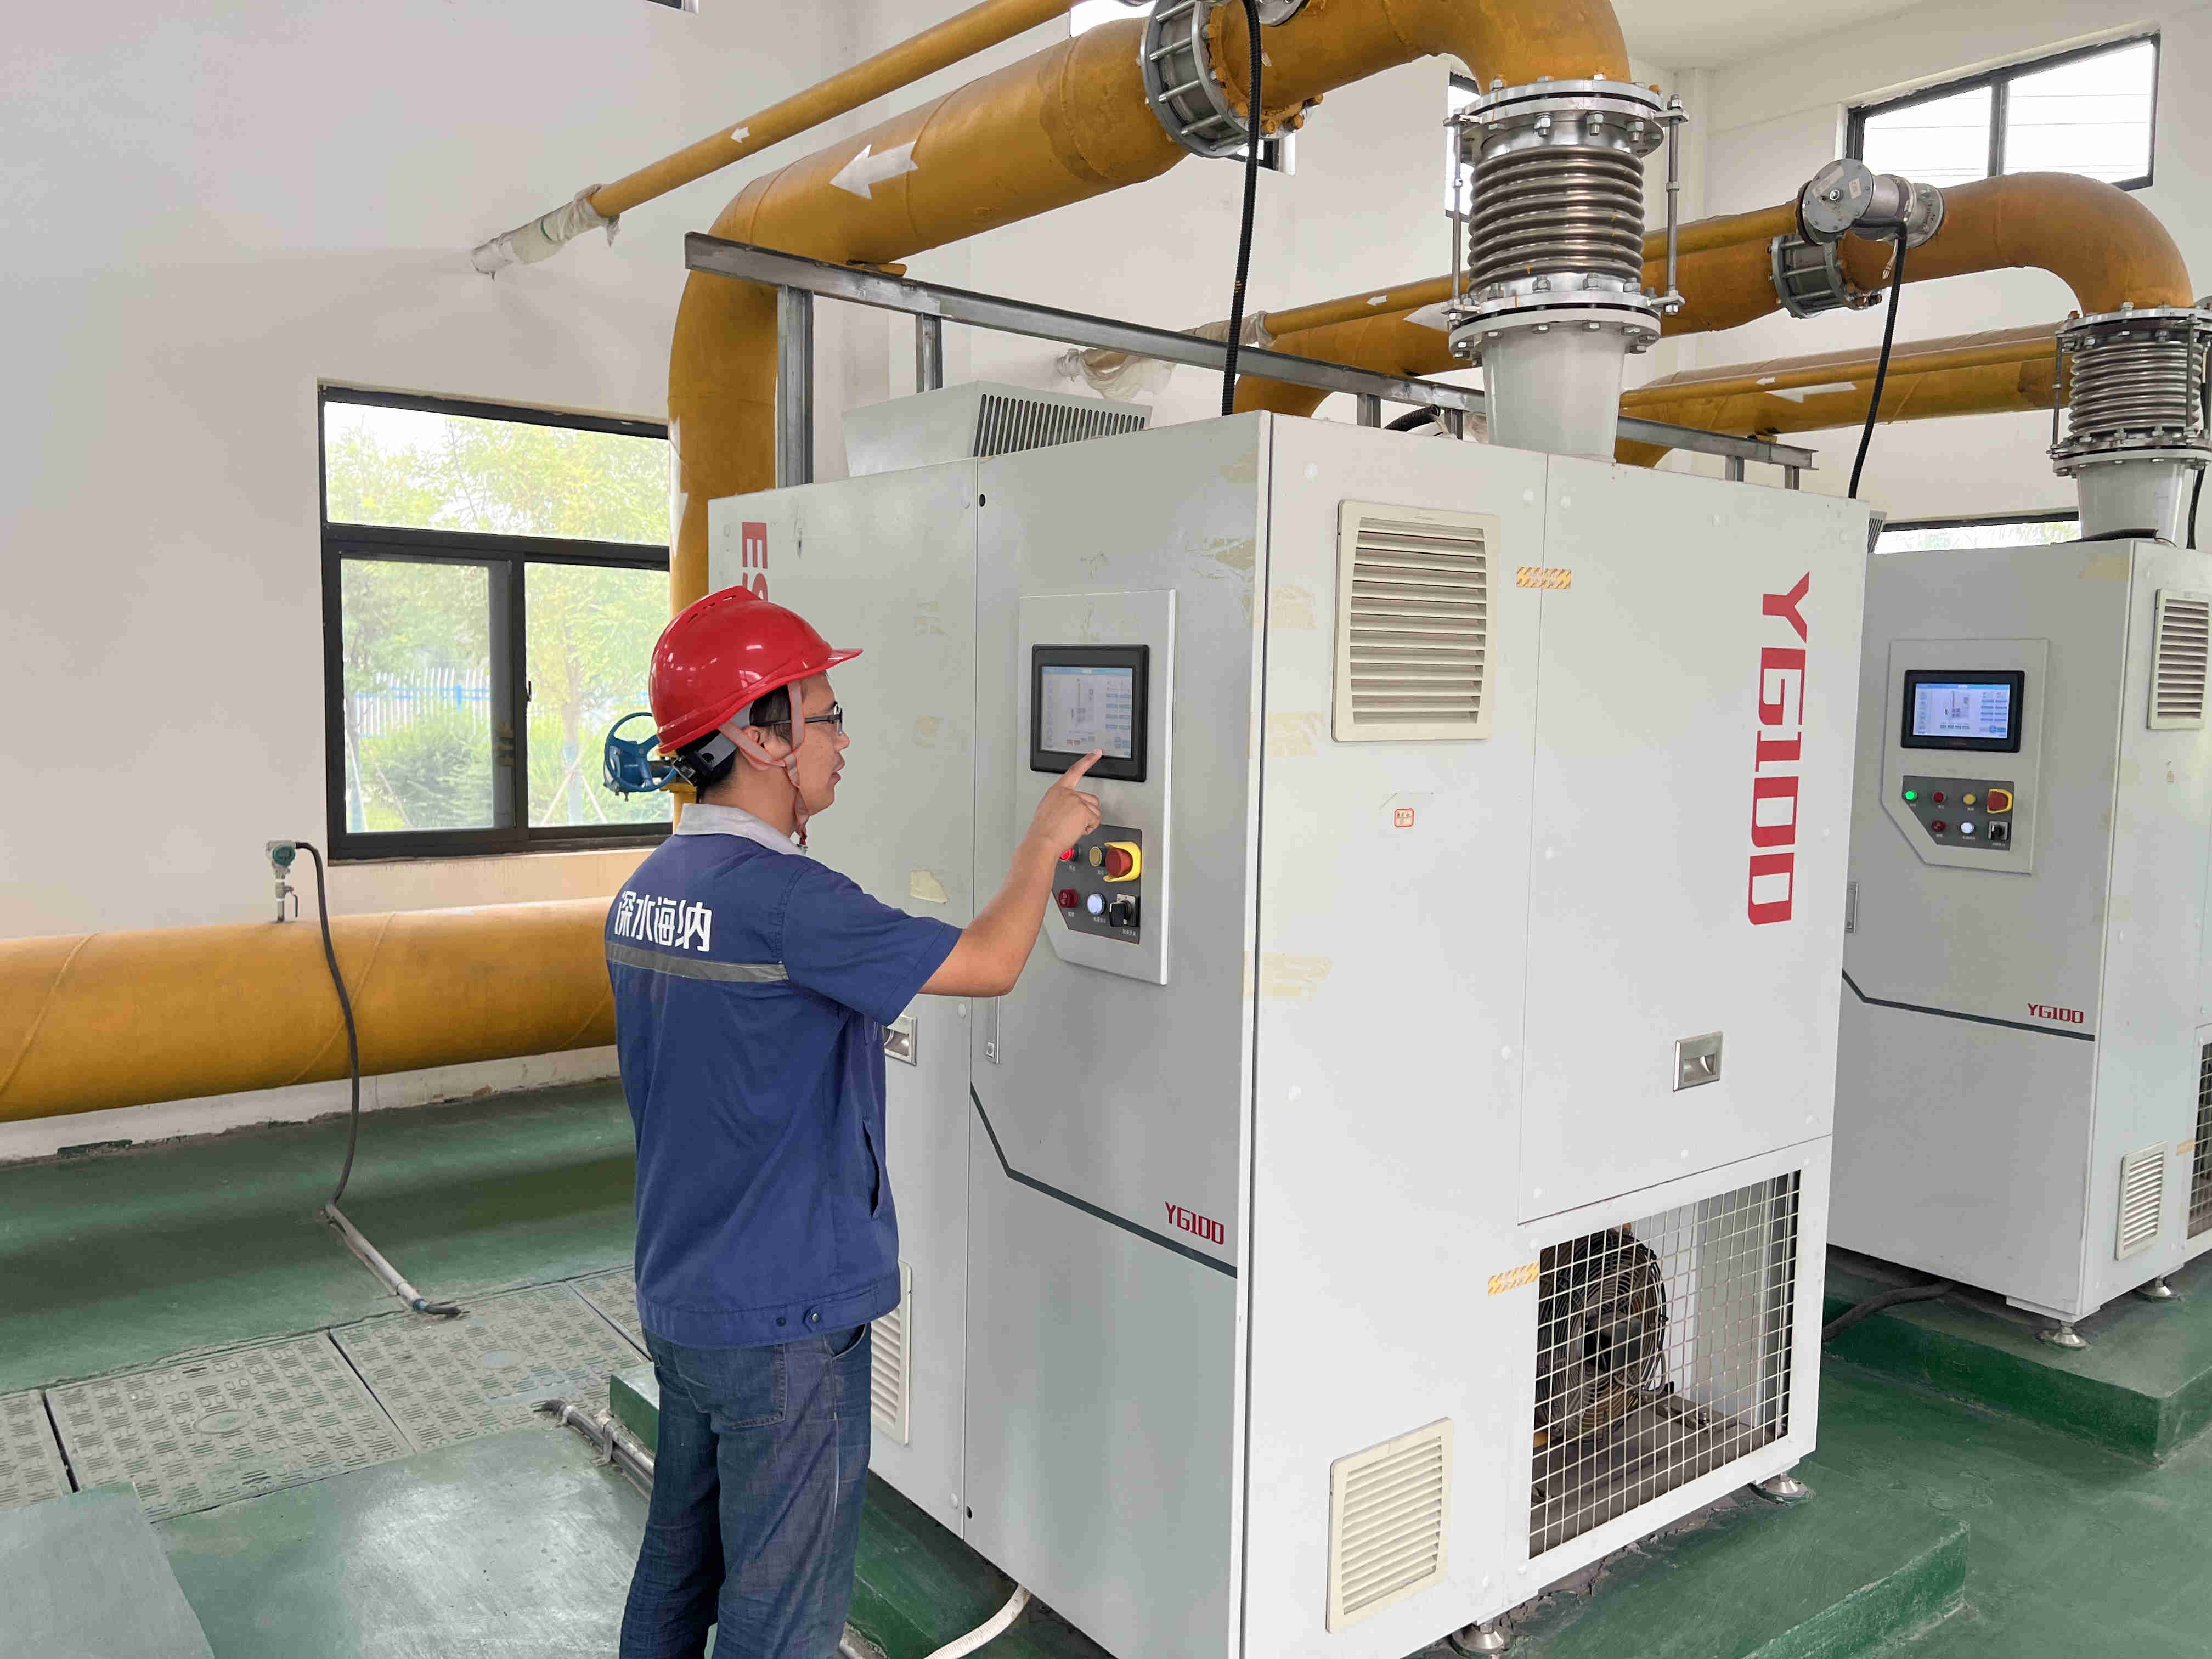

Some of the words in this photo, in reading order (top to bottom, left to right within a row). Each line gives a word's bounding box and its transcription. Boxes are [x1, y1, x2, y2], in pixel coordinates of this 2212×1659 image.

[1748, 572, 1810, 926] YG100
[614, 890, 713, 952] 深水海纳
[2027, 1003, 2084, 1024] YG100
[1165, 1201, 1224, 1245] YG100
